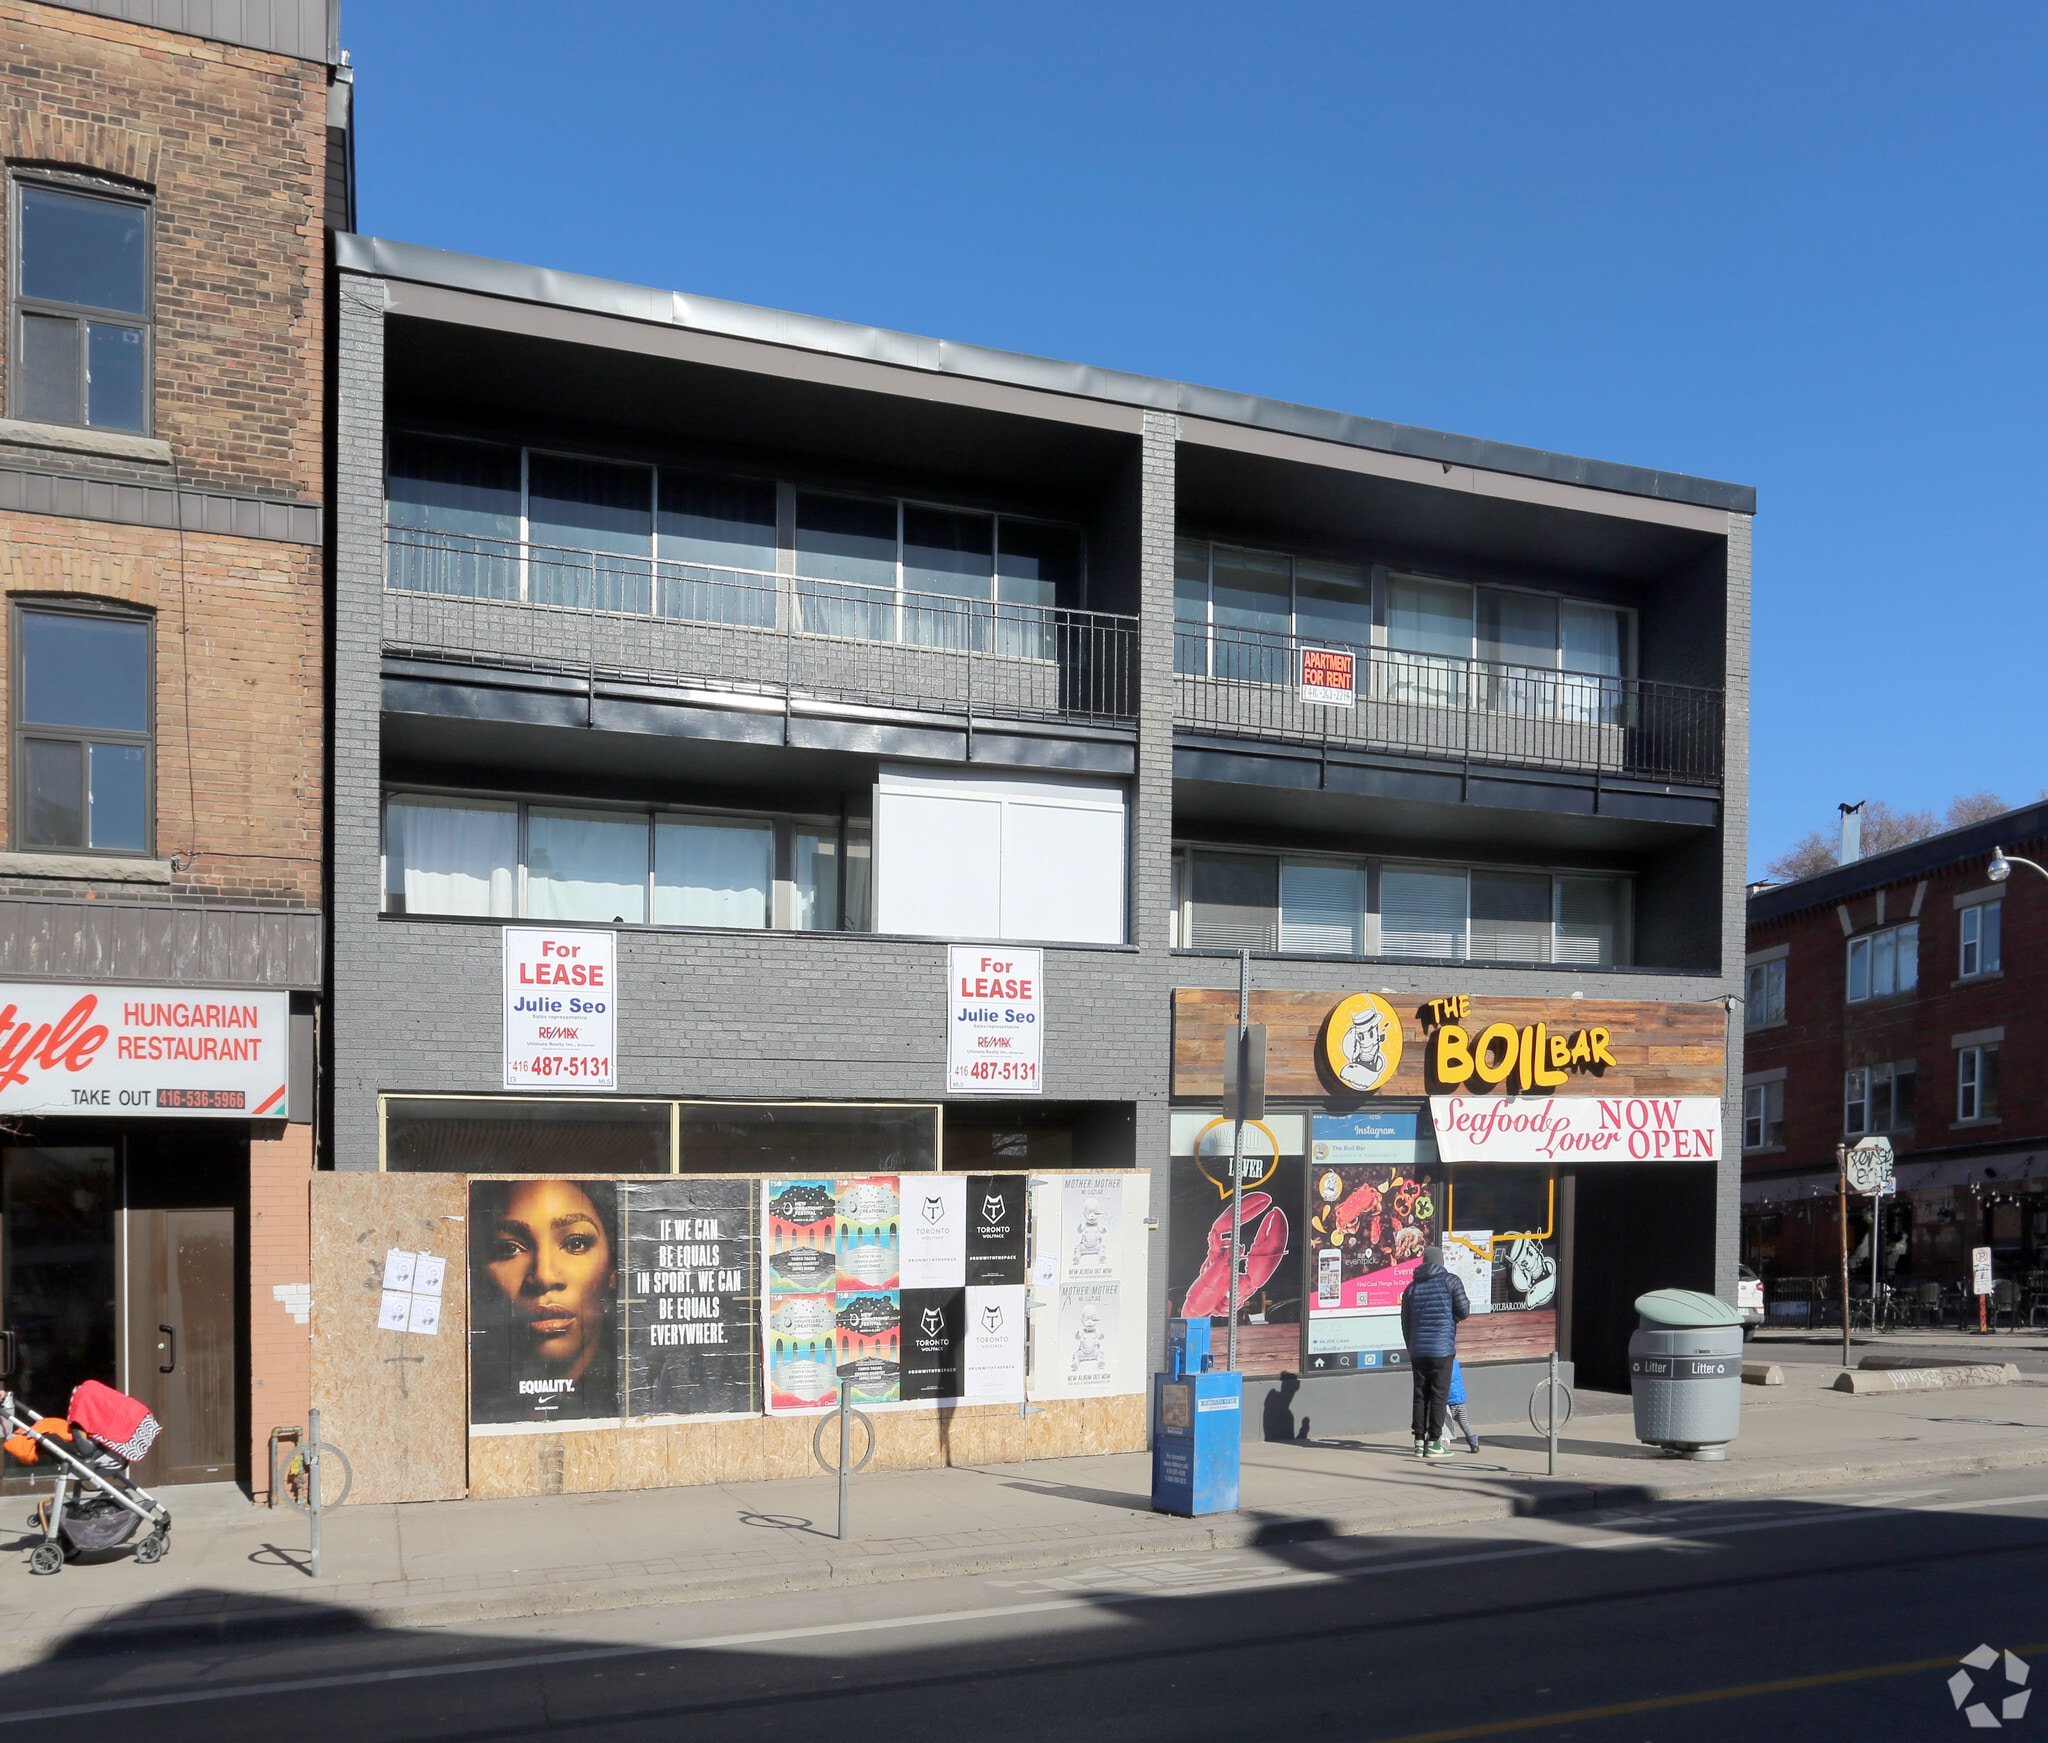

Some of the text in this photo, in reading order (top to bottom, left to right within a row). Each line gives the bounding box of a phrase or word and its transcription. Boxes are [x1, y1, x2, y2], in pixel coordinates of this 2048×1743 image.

[1304, 651, 1352, 673] APARTMENT
[1304, 668, 1352, 690] FOR RENT
[542, 940, 581, 958] For
[519, 962, 604, 987] LEASE
[980, 957, 1013, 974] For
[961, 977, 1032, 1000] LEASE
[124, 1002, 258, 1029] HUNGARIAN
[513, 996, 606, 1014] Julie Seo
[957, 1007, 1036, 1024] Julie Seo
[1428, 994, 1471, 1024] THE
[538, 1026, 579, 1040] RE/MAX
[977, 1035, 1012, 1048] RE/MAX
[117, 1035, 262, 1062] RESTAURANT
[1437, 1021, 1617, 1090] BOIL BAR
[512, 1056, 609, 1077] 416 487-5131
[954, 1061, 1036, 1081] 416 487-5131
[71, 1088, 244, 1108] TAKE OUT 416-536-5966
[1598, 1099, 1683, 1130] NOW
[1353, 1125, 1396, 1139] Instagram
[1434, 1098, 1622, 1160] Seafood Lover
[1627, 1128, 1714, 1160] OPEN
[1228, 1157, 1263, 1178] LVER
[1064, 1178, 1121, 1189] MOTHER MOTHER
[660, 1218, 718, 1241] IF WE CAN
[659, 1244, 720, 1268] BE EQUALS
[1393, 1267, 1414, 1276] Event
[637, 1270, 741, 1295] IN SPORT, WE CAN
[1061, 1285, 1118, 1296] MOTHER MOTHER
[659, 1297, 720, 1320] BE EQUALS
[650, 1322, 729, 1346] EVERYWHERE.
[1644, 1360, 1667, 1373] Litter
[1691, 1362, 1715, 1374] Litter
[519, 1379, 575, 1394] EQUALITY.
